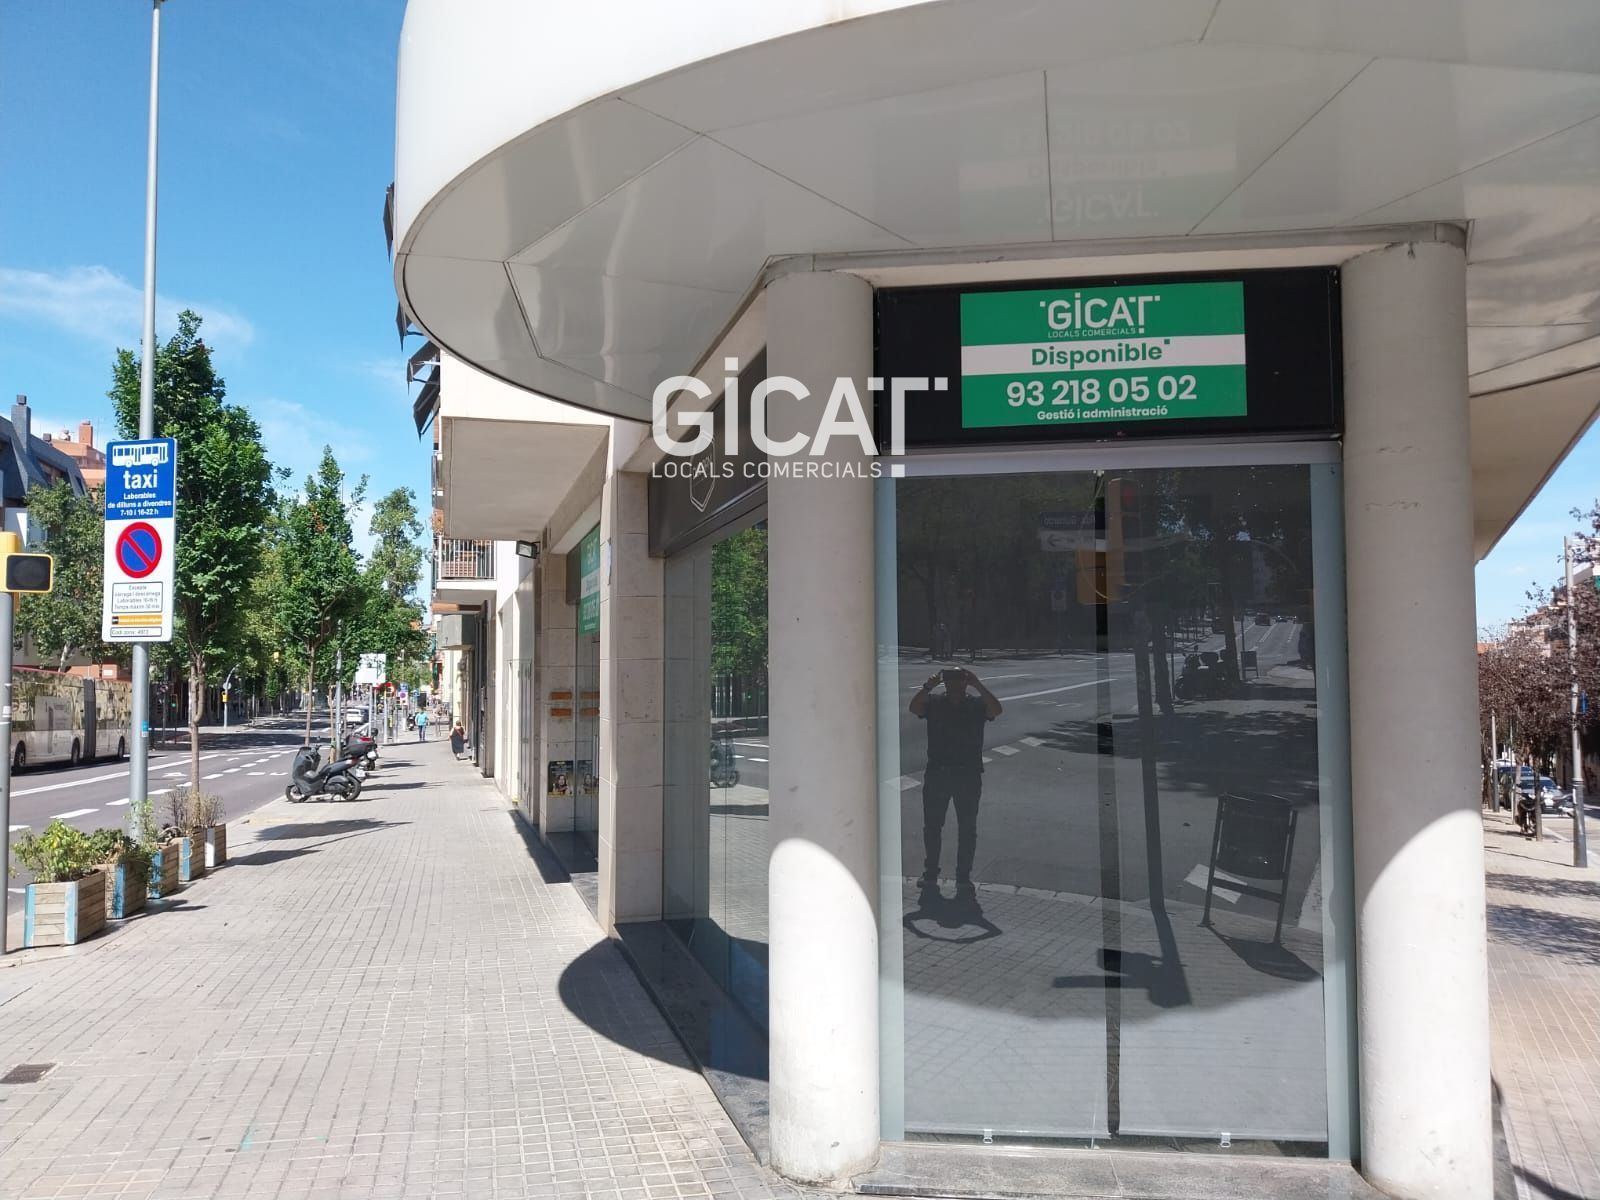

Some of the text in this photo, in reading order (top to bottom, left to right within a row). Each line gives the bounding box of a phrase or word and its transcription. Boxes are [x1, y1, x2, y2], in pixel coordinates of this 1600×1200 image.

[1048, 328, 1136, 338] LOCALS COMERCIALS
[1031, 343, 1163, 369] Disponible
[1006, 374, 1198, 407] 93 218 05 02
[1036, 405, 1168, 421] Gestió i administració
[123, 468, 158, 490] taxi
